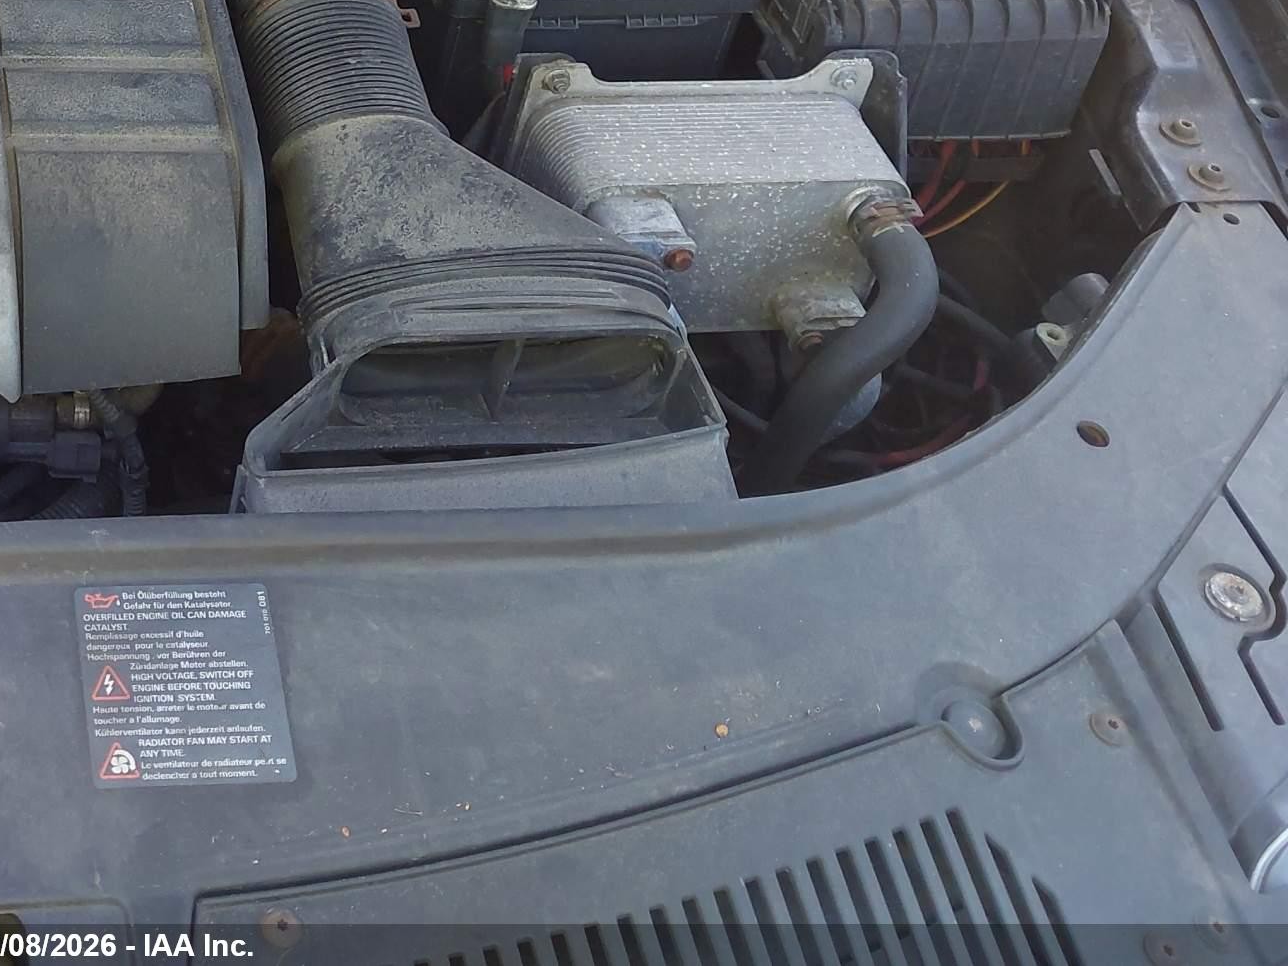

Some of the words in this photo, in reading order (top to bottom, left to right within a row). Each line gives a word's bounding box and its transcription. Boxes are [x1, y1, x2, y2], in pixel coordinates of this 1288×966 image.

[122, 592, 136, 600] Bei
[137, 590, 193, 600] Ölüberfüllung
[256, 591, 266, 607] 081
[123, 602, 151, 610] Gefahr
[153, 601, 165, 609] für
[167, 601, 183, 609] den
[184, 601, 232, 609] Katalysator.
[83, 613, 135, 622] OVERFILLED
[137, 612, 169, 621] ENGINE
[171, 611, 186, 619] OIL
[187, 611, 207, 619] CAN
[208, 610, 247, 618] DAMAGE
[85, 632, 138, 641] Remplissage
[140, 631, 173, 639] excessif
[86, 643, 131, 652] dangereux
[134, 643, 153, 652] pour
[172, 651, 210, 659] Berühren
[212, 650, 226, 658] der
[129, 662, 179, 671] Zündanlage
[180, 661, 206, 669] Motor
[208, 660, 248, 668] abstellen.
[131, 673, 153, 682] HIGH
[199, 671, 235, 679] SWITCH
[236, 670, 254, 679] OFF
[132, 684, 166, 692] ENGINE
[167, 683, 202, 691] BEFORE
[204, 681, 252, 690] TOUCHING
[133, 694, 174, 703] IGNITION
[92, 706, 119, 714] Haute
[229, 702, 254, 710] avant
[254, 701, 266, 709] de
[93, 717, 127, 725] toucher
[95, 728, 163, 737] Kühlerventilator
[164, 727, 187, 735] kann
[188, 725, 225, 735] jederzeit
[226, 724, 266, 733] anlaufen.
[138, 737, 185, 747] RADIATOR
[186, 737, 205, 746] FAN
[206, 736, 228, 745] MAY
[229, 735, 259, 744] START
[260, 734, 273, 743] AT
[140, 749, 159, 758] ANY
[153, 760, 199, 769] ventilateur
[201, 759, 213, 767] de
[214, 758, 252, 767] radiateur
[199, 771, 217, 779] tout
[219, 769, 258, 778] moment.
